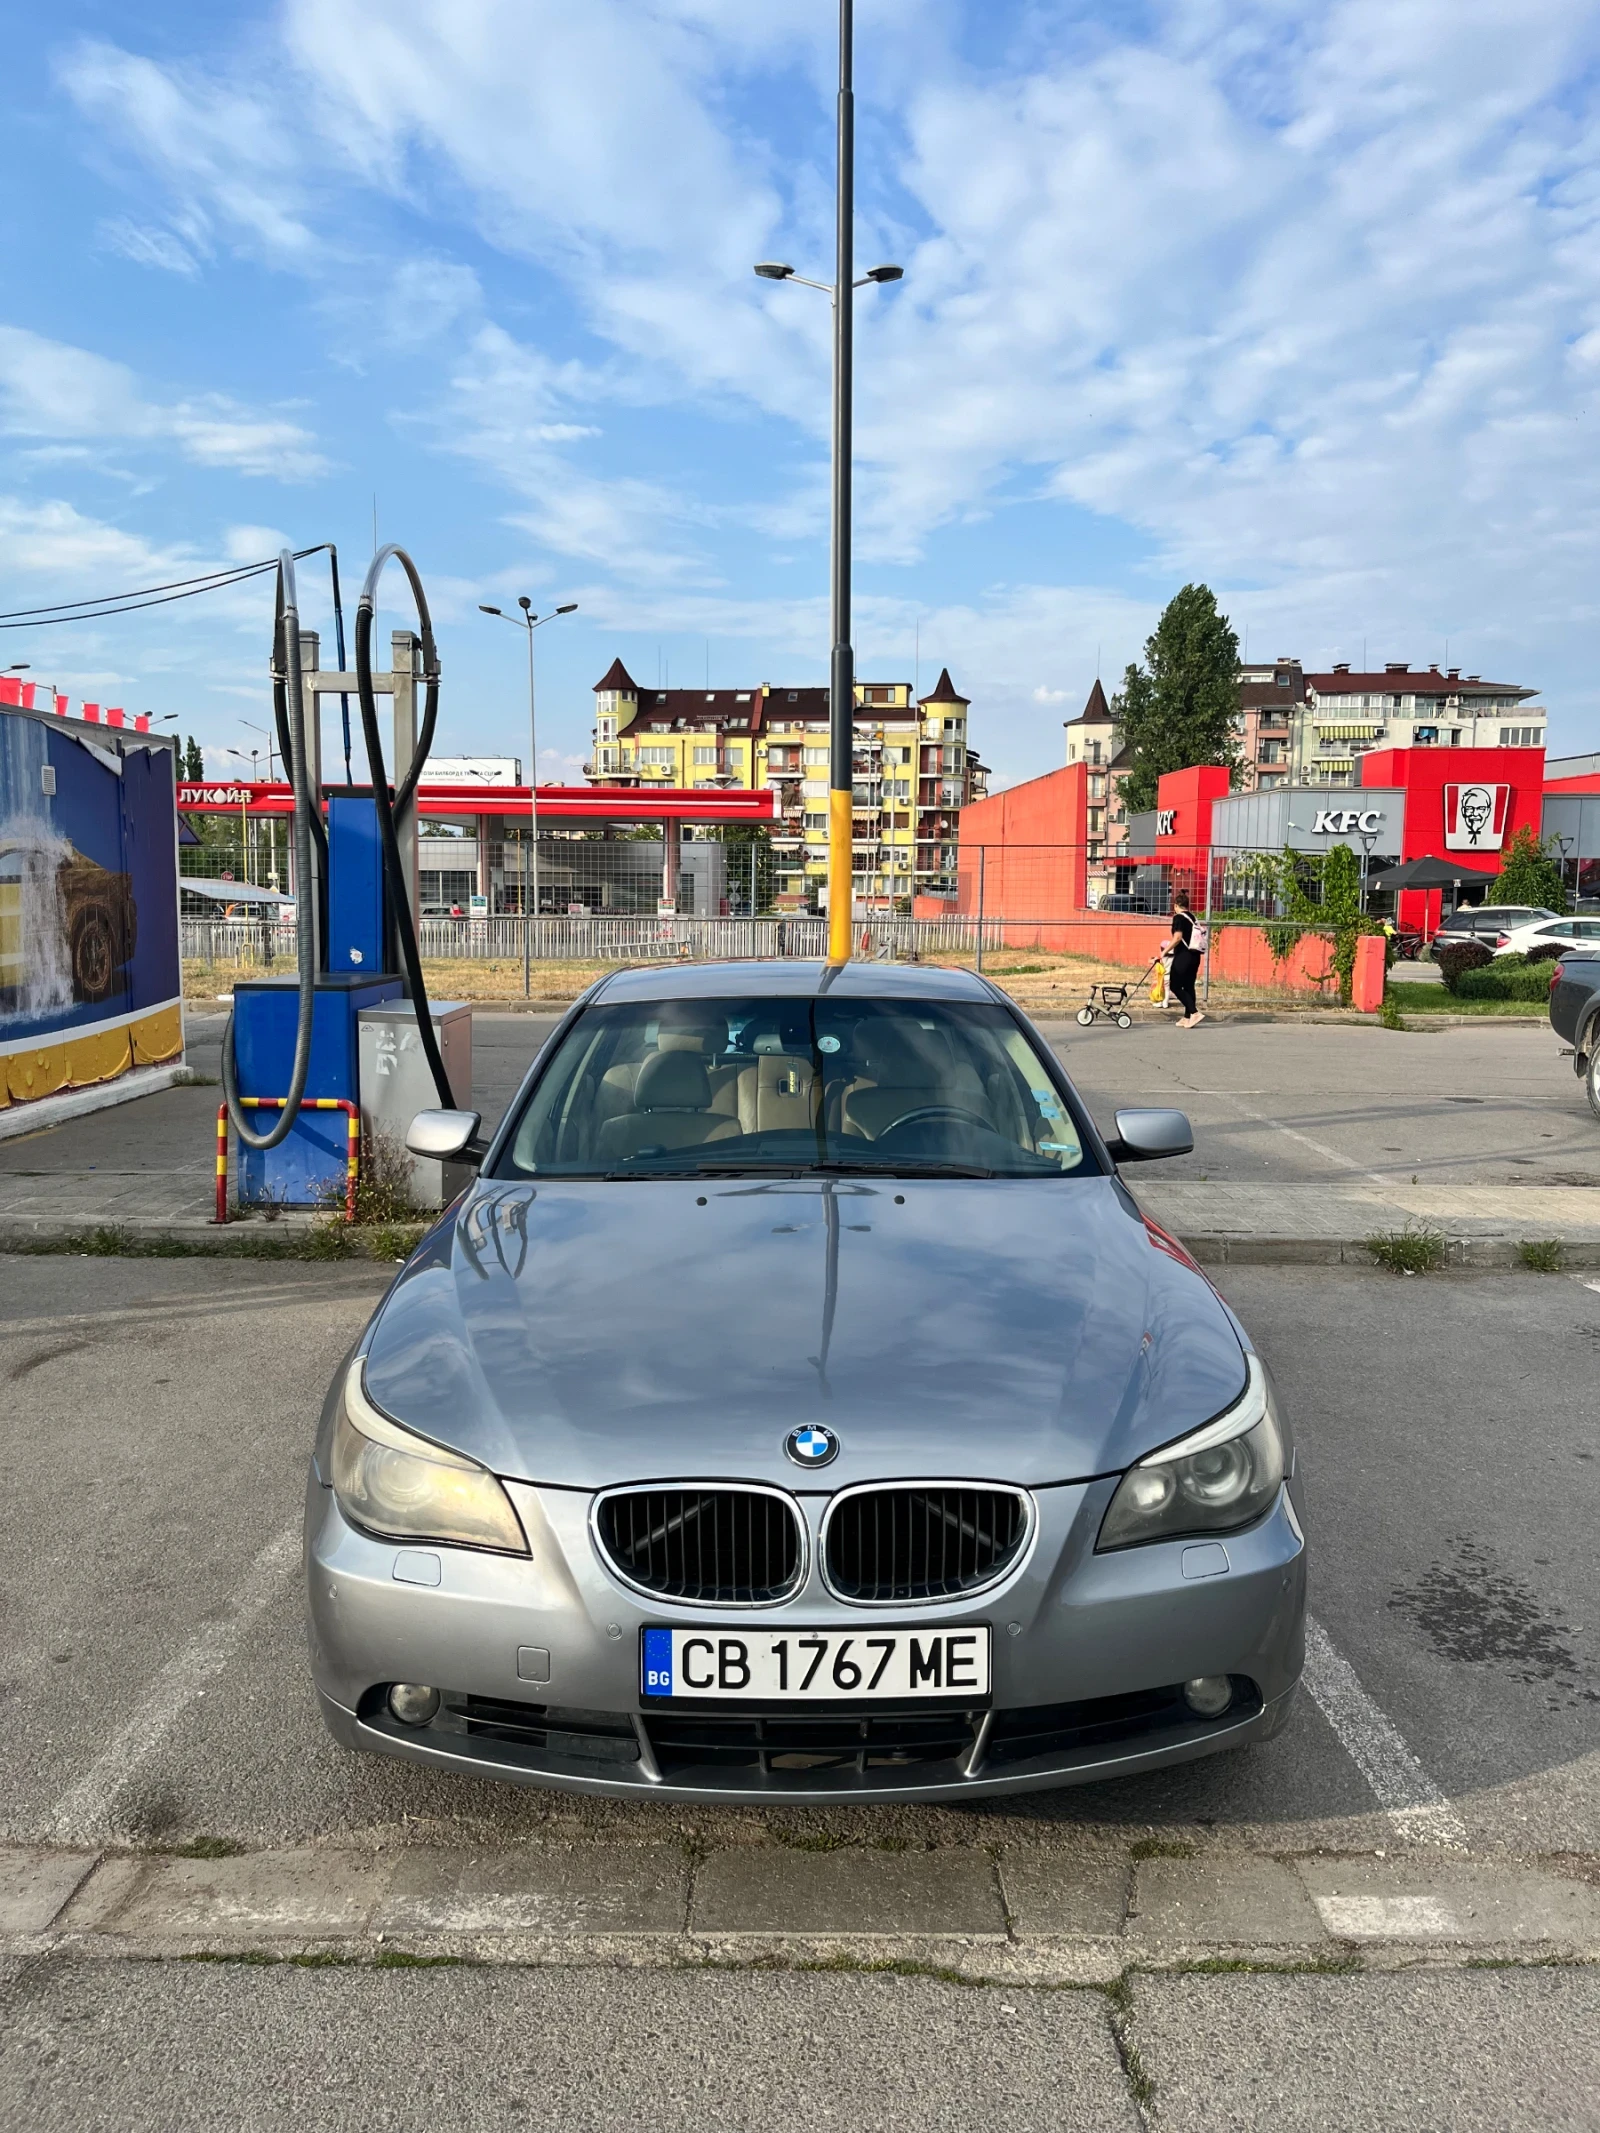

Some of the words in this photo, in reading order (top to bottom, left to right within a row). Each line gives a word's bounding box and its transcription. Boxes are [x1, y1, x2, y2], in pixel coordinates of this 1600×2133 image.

[180, 787, 251, 804] ЛУКОЙЛ
[1156, 810, 1175, 835] KFC
[1311, 810, 1381, 833] KFC
[792, 1425, 833, 1437] BMW
[681, 1637, 750, 1690] CB
[771, 1638, 897, 1691] 1767
[909, 1636, 978, 1689] ME
[648, 1670, 670, 1686] BG
